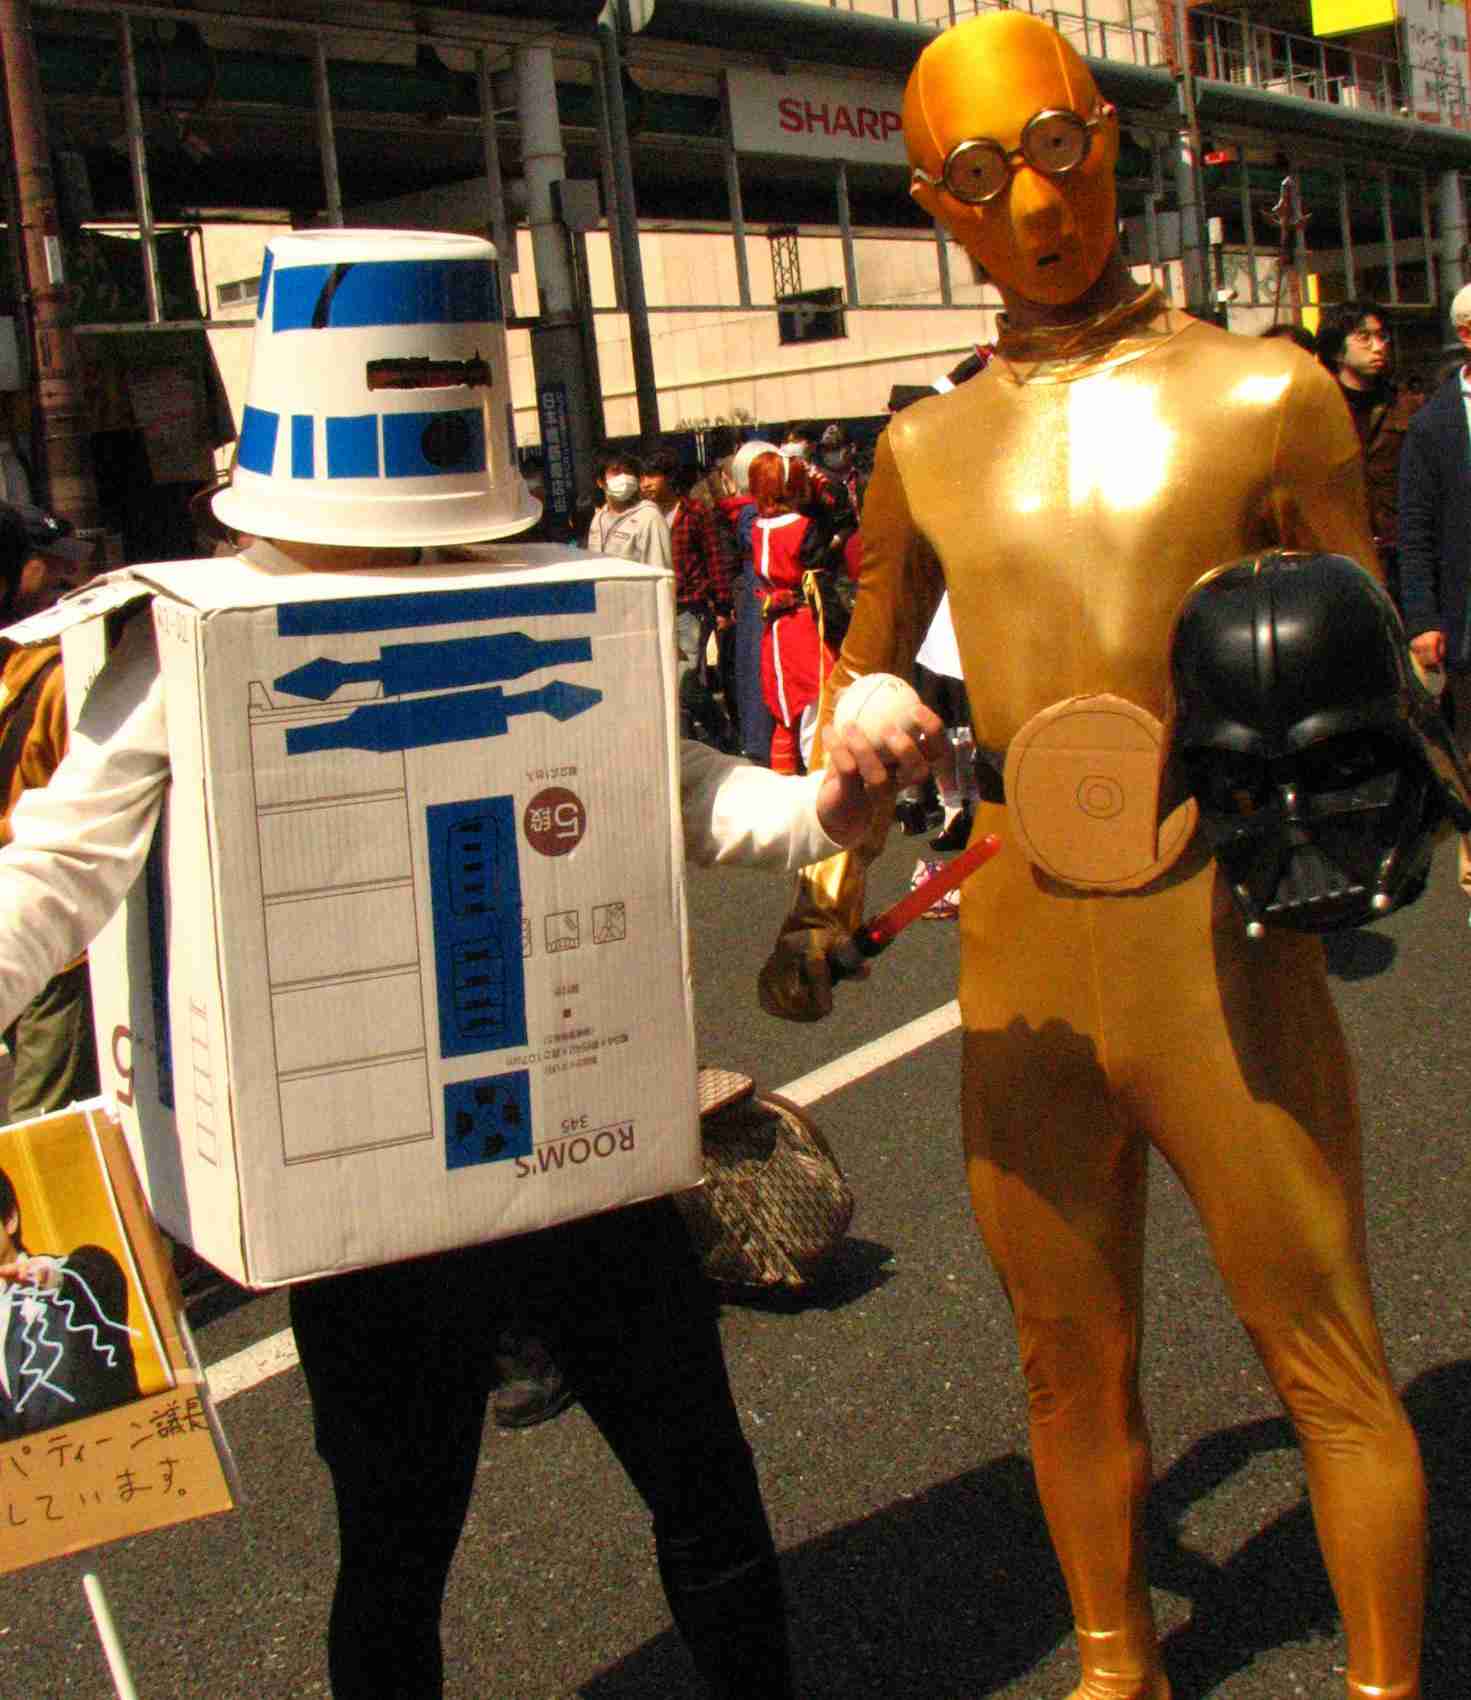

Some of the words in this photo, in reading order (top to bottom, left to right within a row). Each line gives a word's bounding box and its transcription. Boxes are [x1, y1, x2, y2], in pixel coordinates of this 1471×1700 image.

[778, 97, 903, 141] SHARP
[561, 1114, 589, 1133] 345
[515, 1125, 635, 1178] ROOM'S
